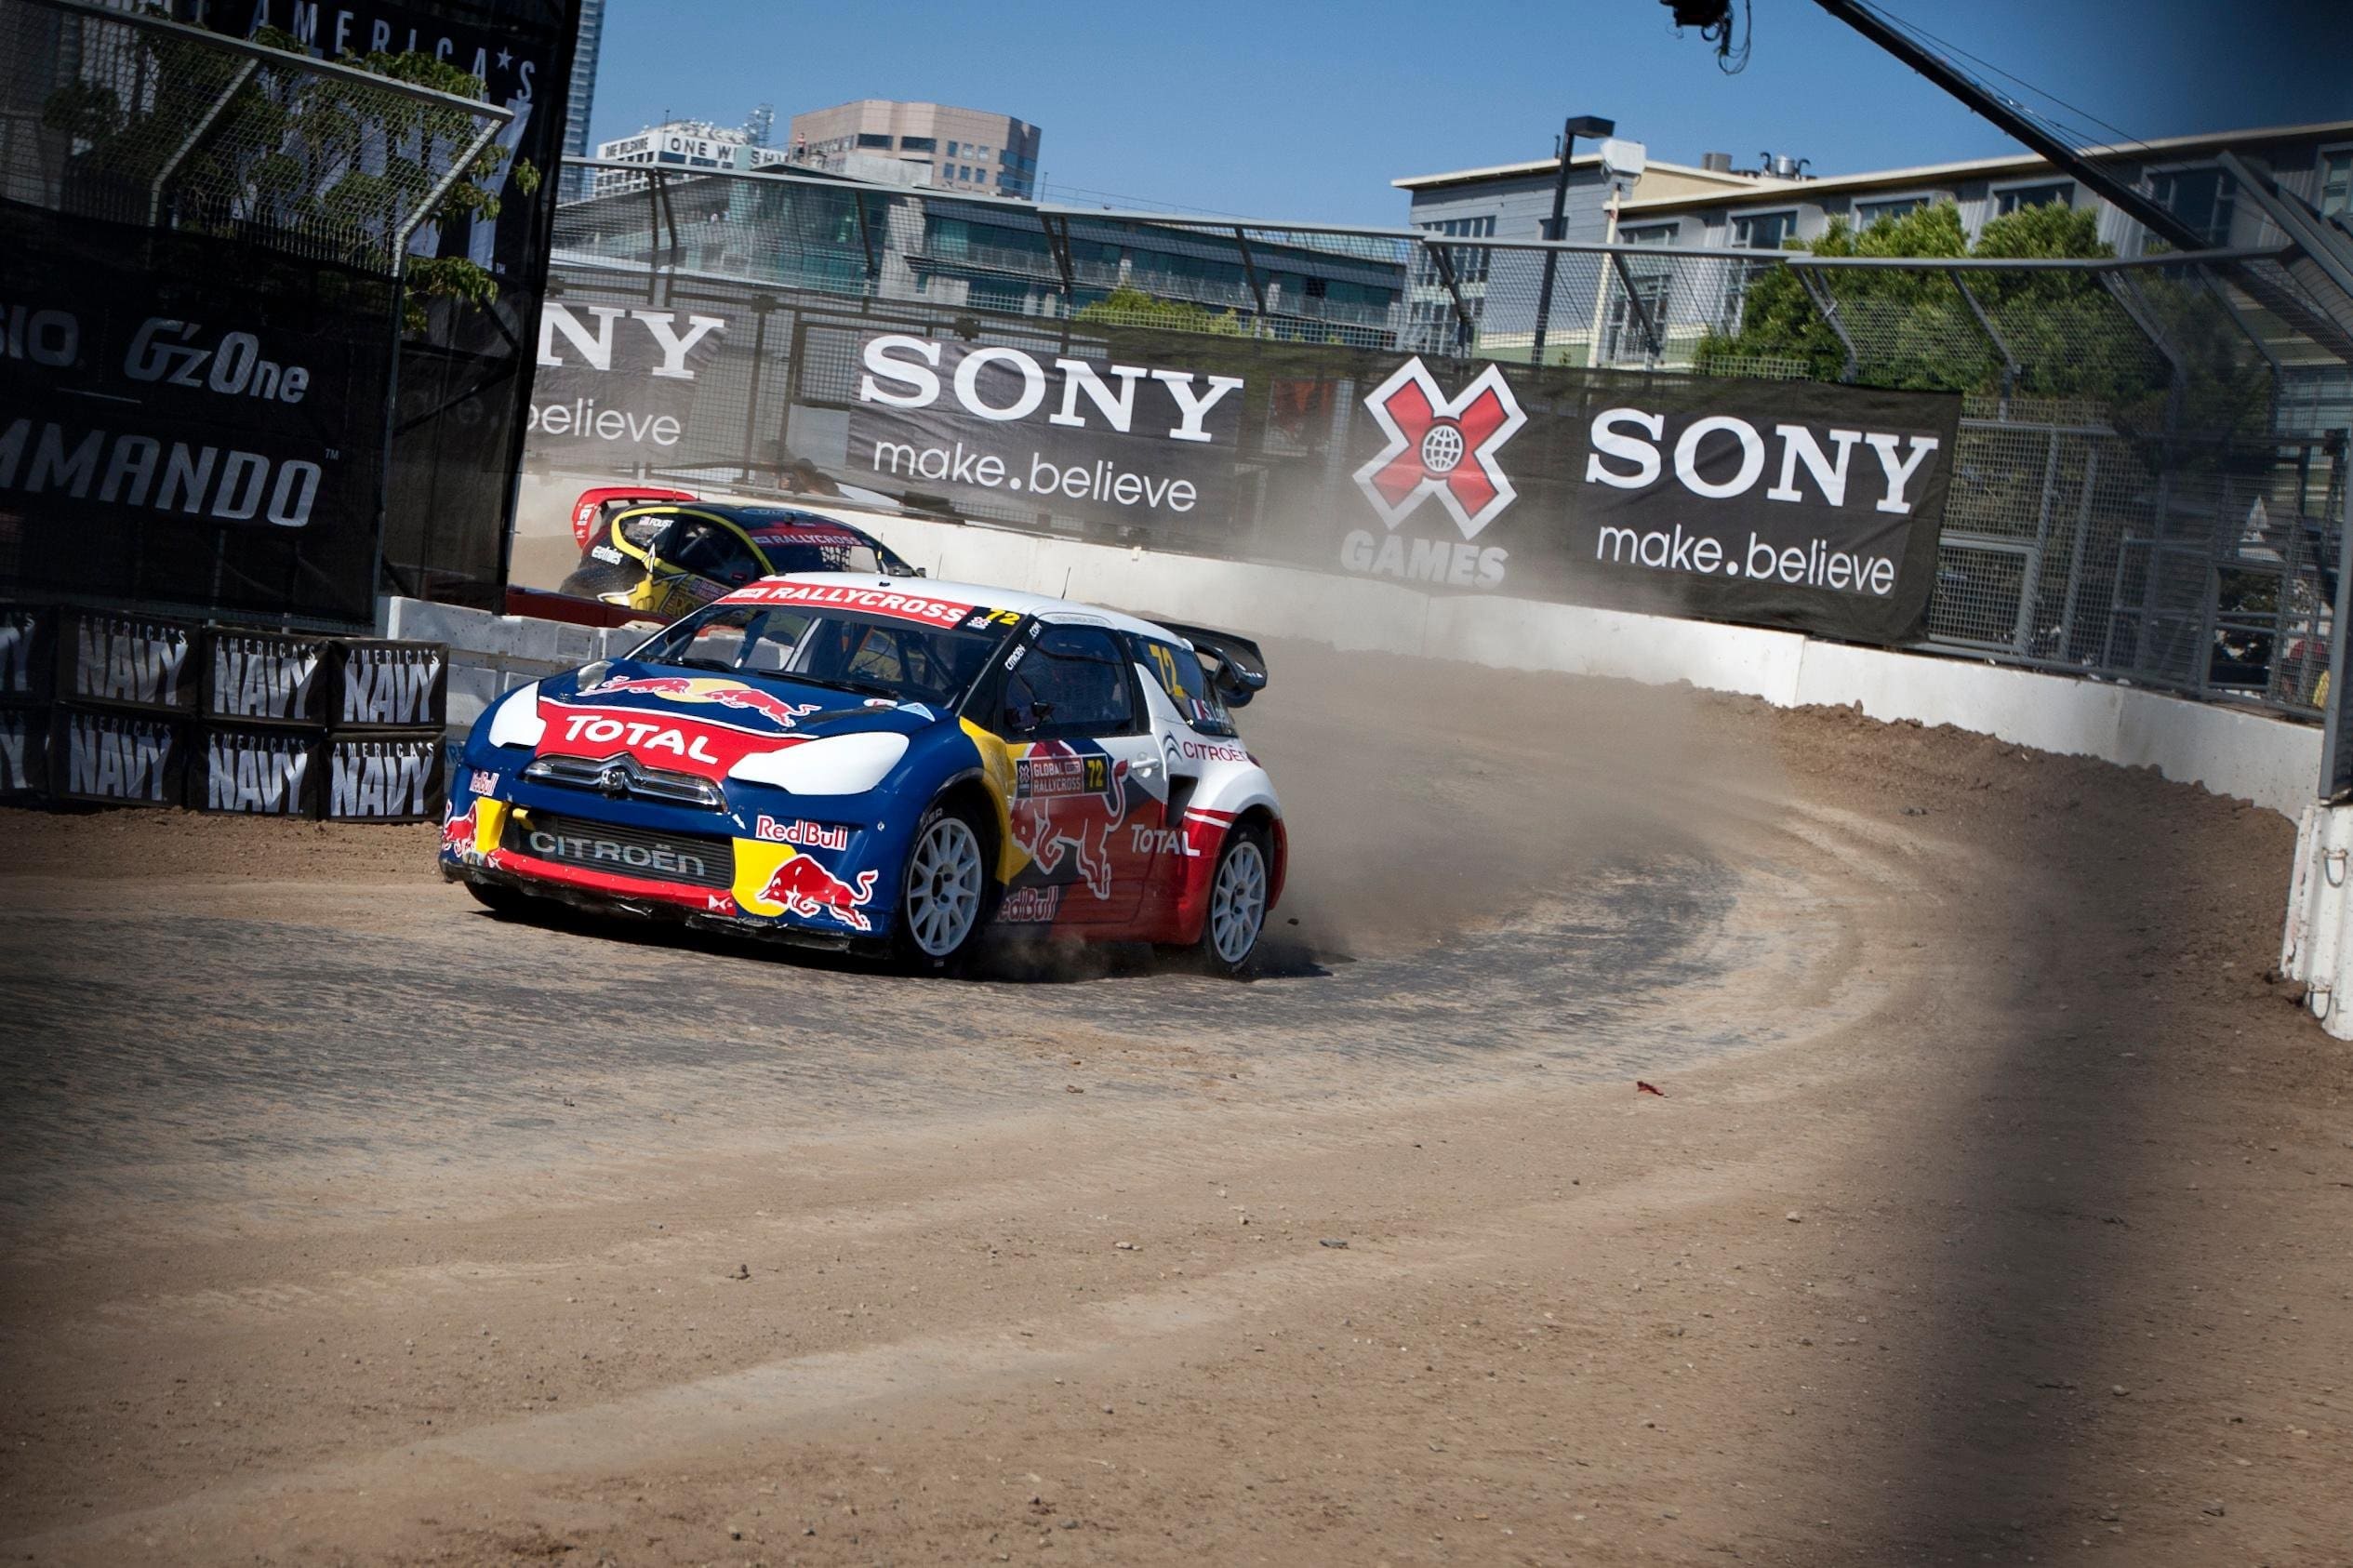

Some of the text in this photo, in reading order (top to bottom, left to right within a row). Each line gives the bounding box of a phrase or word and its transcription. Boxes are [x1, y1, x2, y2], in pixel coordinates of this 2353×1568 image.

[671, 137, 707, 156] ONE
[0, 304, 80, 366] IO
[859, 335, 1243, 443] SONY
[874, 440, 1197, 513] make.believe
[1585, 407, 1939, 514] SONY
[771, 534, 863, 546] RALLYCROSS
[1340, 529, 1509, 590] GAMES
[1597, 524, 1894, 595] make.believe
[769, 586, 968, 623] RALLYCROSS
[986, 606, 1021, 626] 72
[76, 629, 189, 707] NAVY
[213, 651, 319, 720] NAVY
[343, 663, 441, 724] NAVY
[1149, 644, 1186, 698] 72
[69, 729, 173, 802] NAVY
[565, 715, 719, 764] TOTAL
[1033, 763, 1065, 777] GLOBAL
[207, 746, 308, 815] NAVY
[330, 756, 433, 817] NAVY
[1033, 777, 1081, 792] RALLYCROSS
[1086, 759, 1104, 789] 72
[1130, 824, 1201, 857] TOTAL
